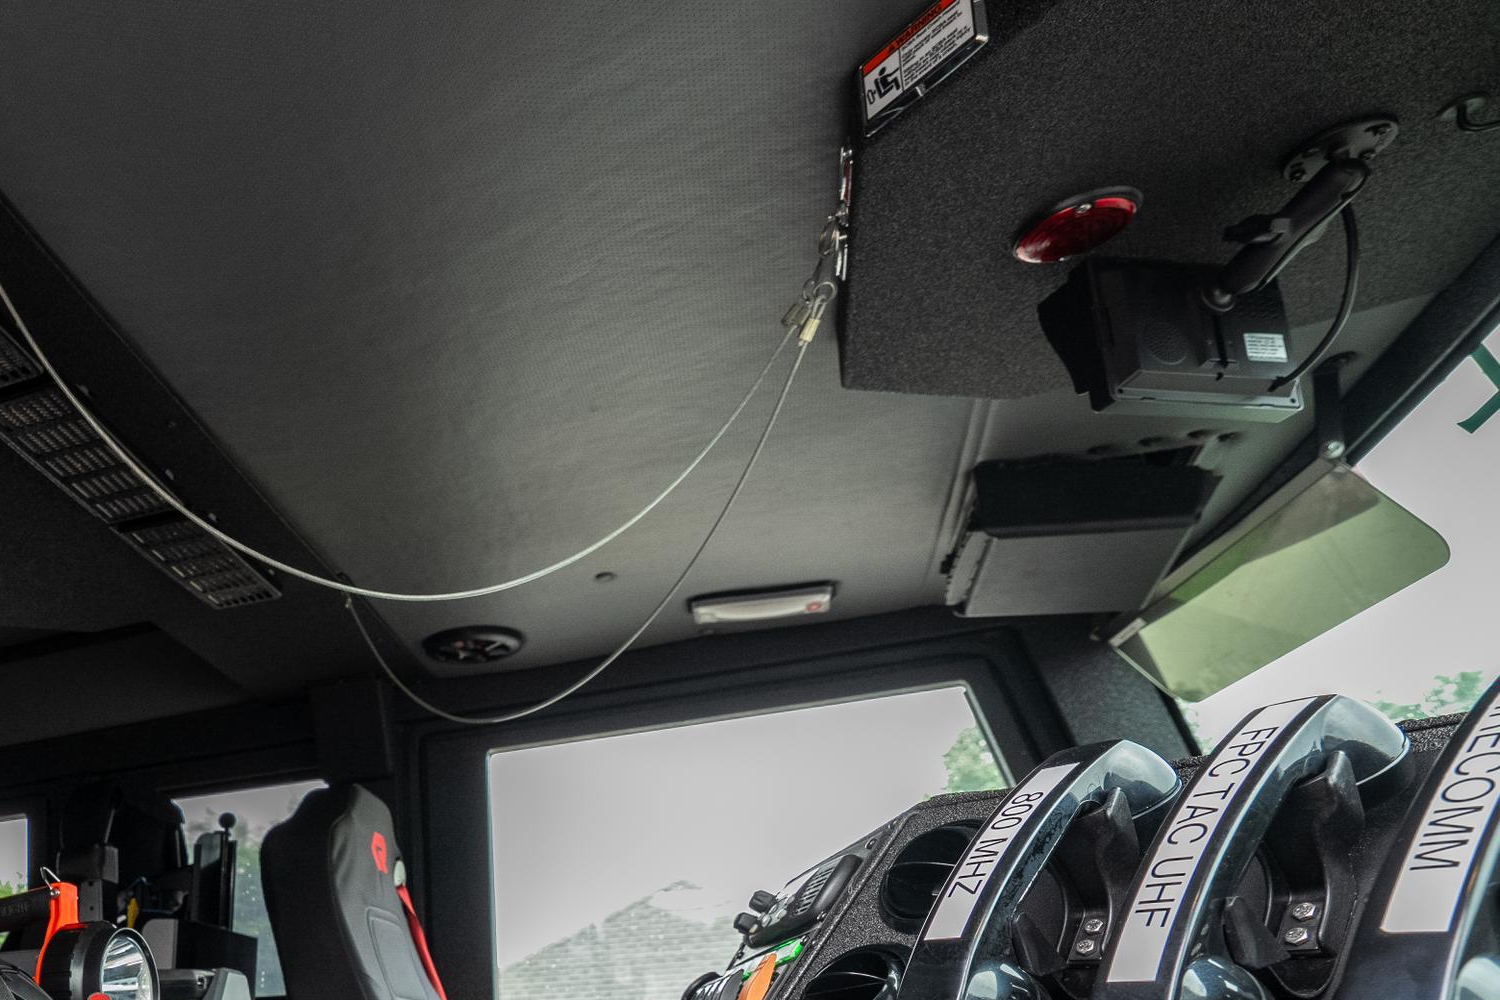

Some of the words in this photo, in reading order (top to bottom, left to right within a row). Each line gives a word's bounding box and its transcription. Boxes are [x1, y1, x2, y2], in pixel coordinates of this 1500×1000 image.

[1209, 726, 1279, 777] FPC
[991, 792, 1044, 830] 800
[1167, 782, 1235, 845] TAC
[1410, 706, 1500, 870] ECOMM
[948, 837, 1009, 897] MHZ
[1135, 856, 1194, 928] UHF
